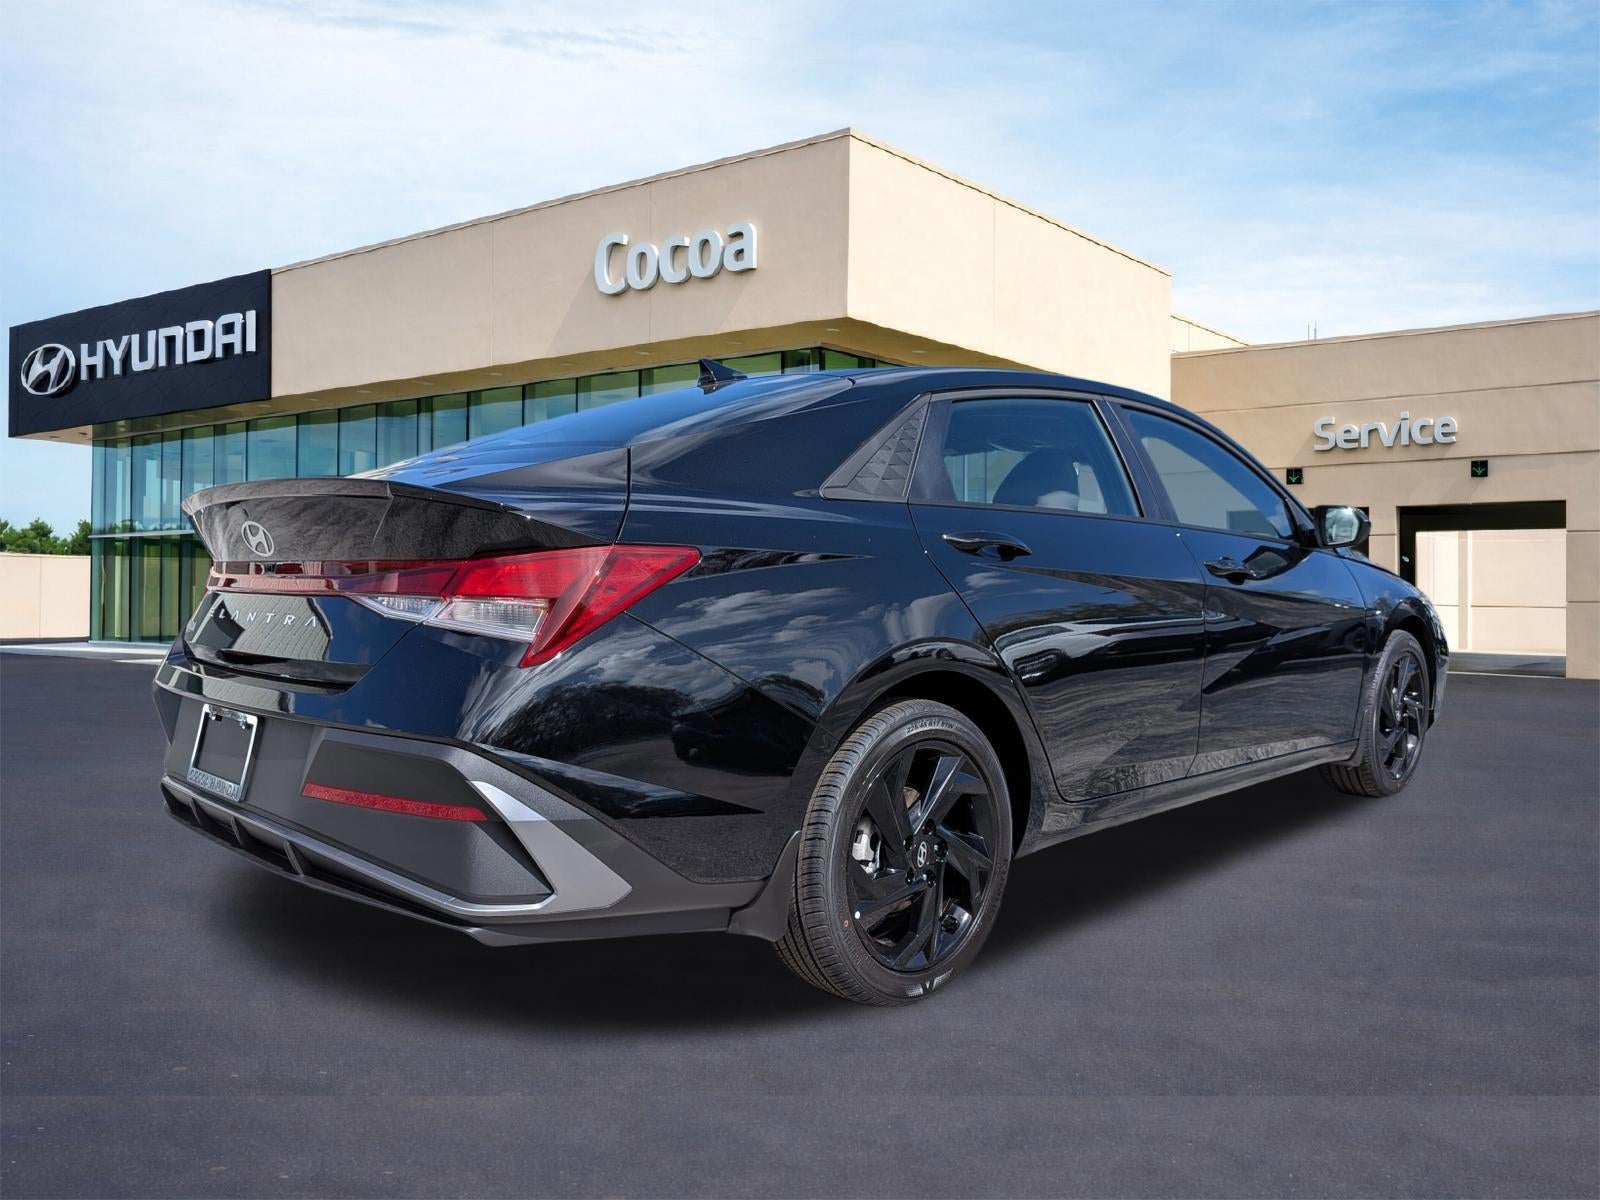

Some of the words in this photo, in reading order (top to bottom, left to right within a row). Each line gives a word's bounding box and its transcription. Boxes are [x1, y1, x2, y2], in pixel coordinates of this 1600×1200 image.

[594, 222, 758, 296] Cocoa
[80, 309, 257, 381] HYUNDAI
[1313, 410, 1458, 452] Service
